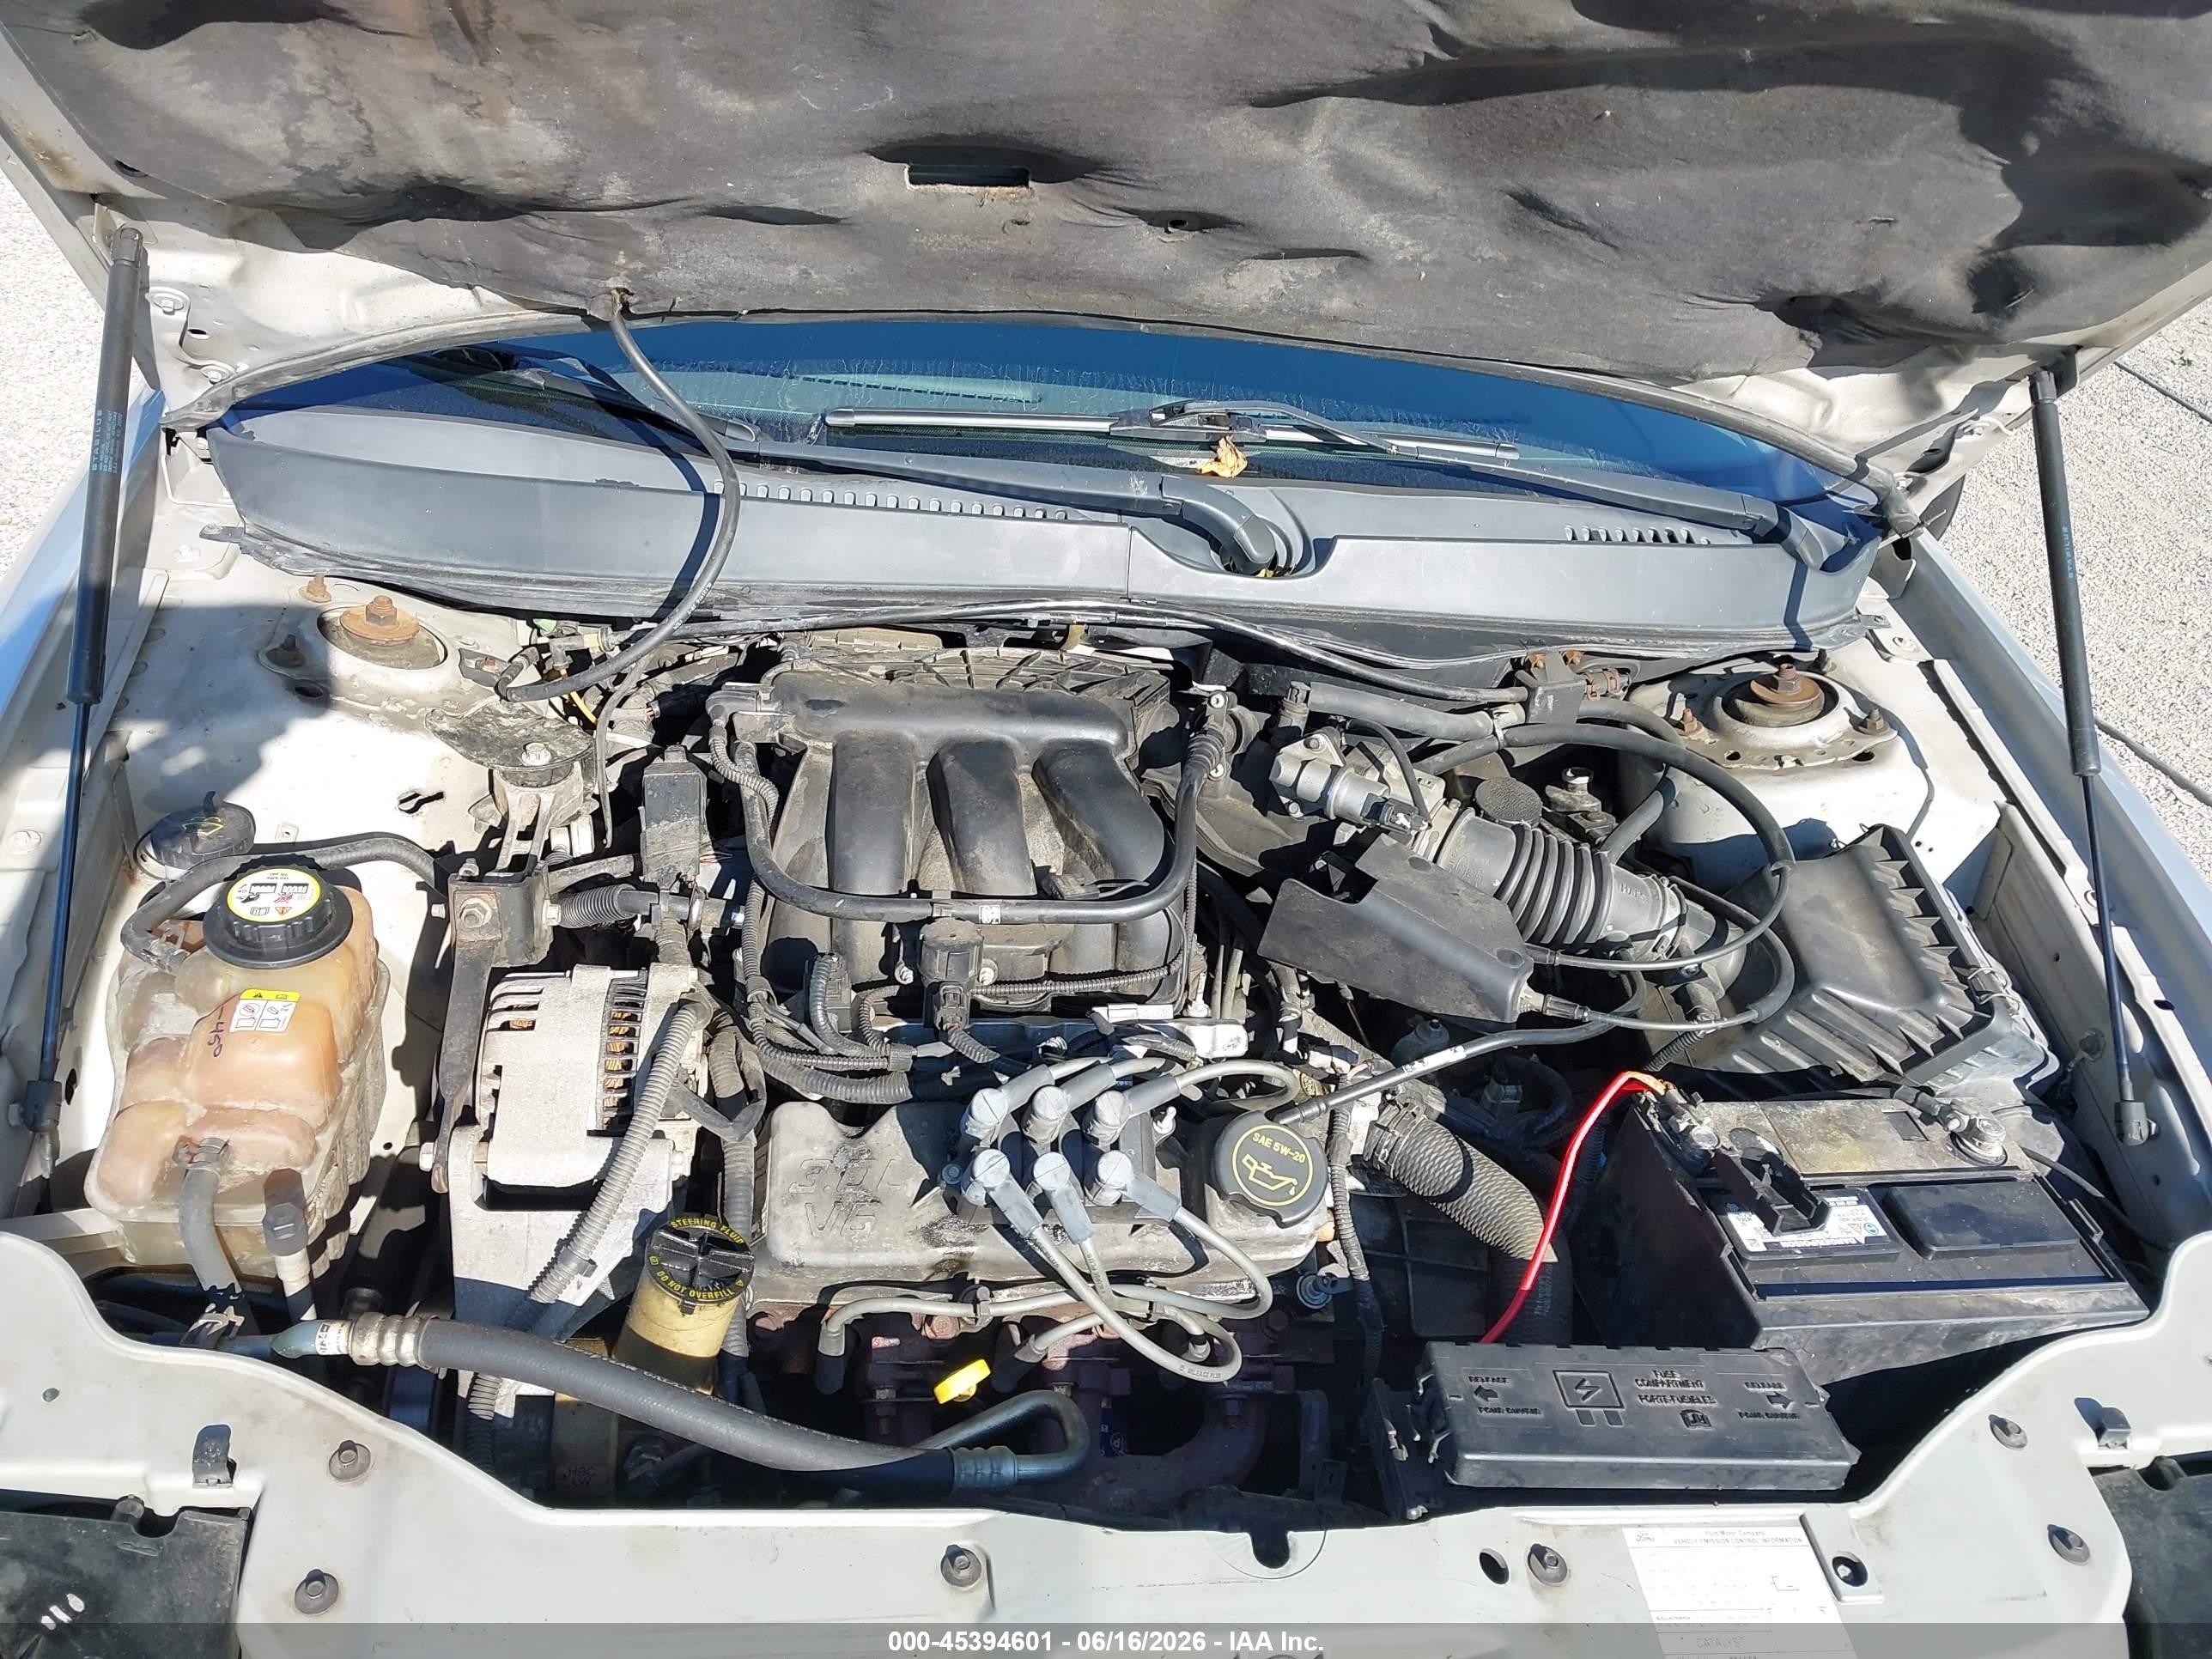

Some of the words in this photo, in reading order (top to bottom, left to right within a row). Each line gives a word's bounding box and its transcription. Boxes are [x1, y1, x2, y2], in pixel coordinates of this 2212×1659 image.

[91, 410, 102, 471] STABILUS
[1252, 1133, 1273, 1148] SAE
[1273, 1141, 1306, 1164] 5W-20
[670, 1218, 717, 1229] STEERING
[720, 1225, 744, 1244] FLUID
[805, 1202, 881, 1238] V6
[656, 1271, 669, 1283] DO
[667, 1279, 687, 1294] NOT
[689, 1288, 735, 1299] OVERFILL
[1634, 1378, 1705, 1389] COMPARTMENT
[1651, 1370, 1680, 1379] FUSE
